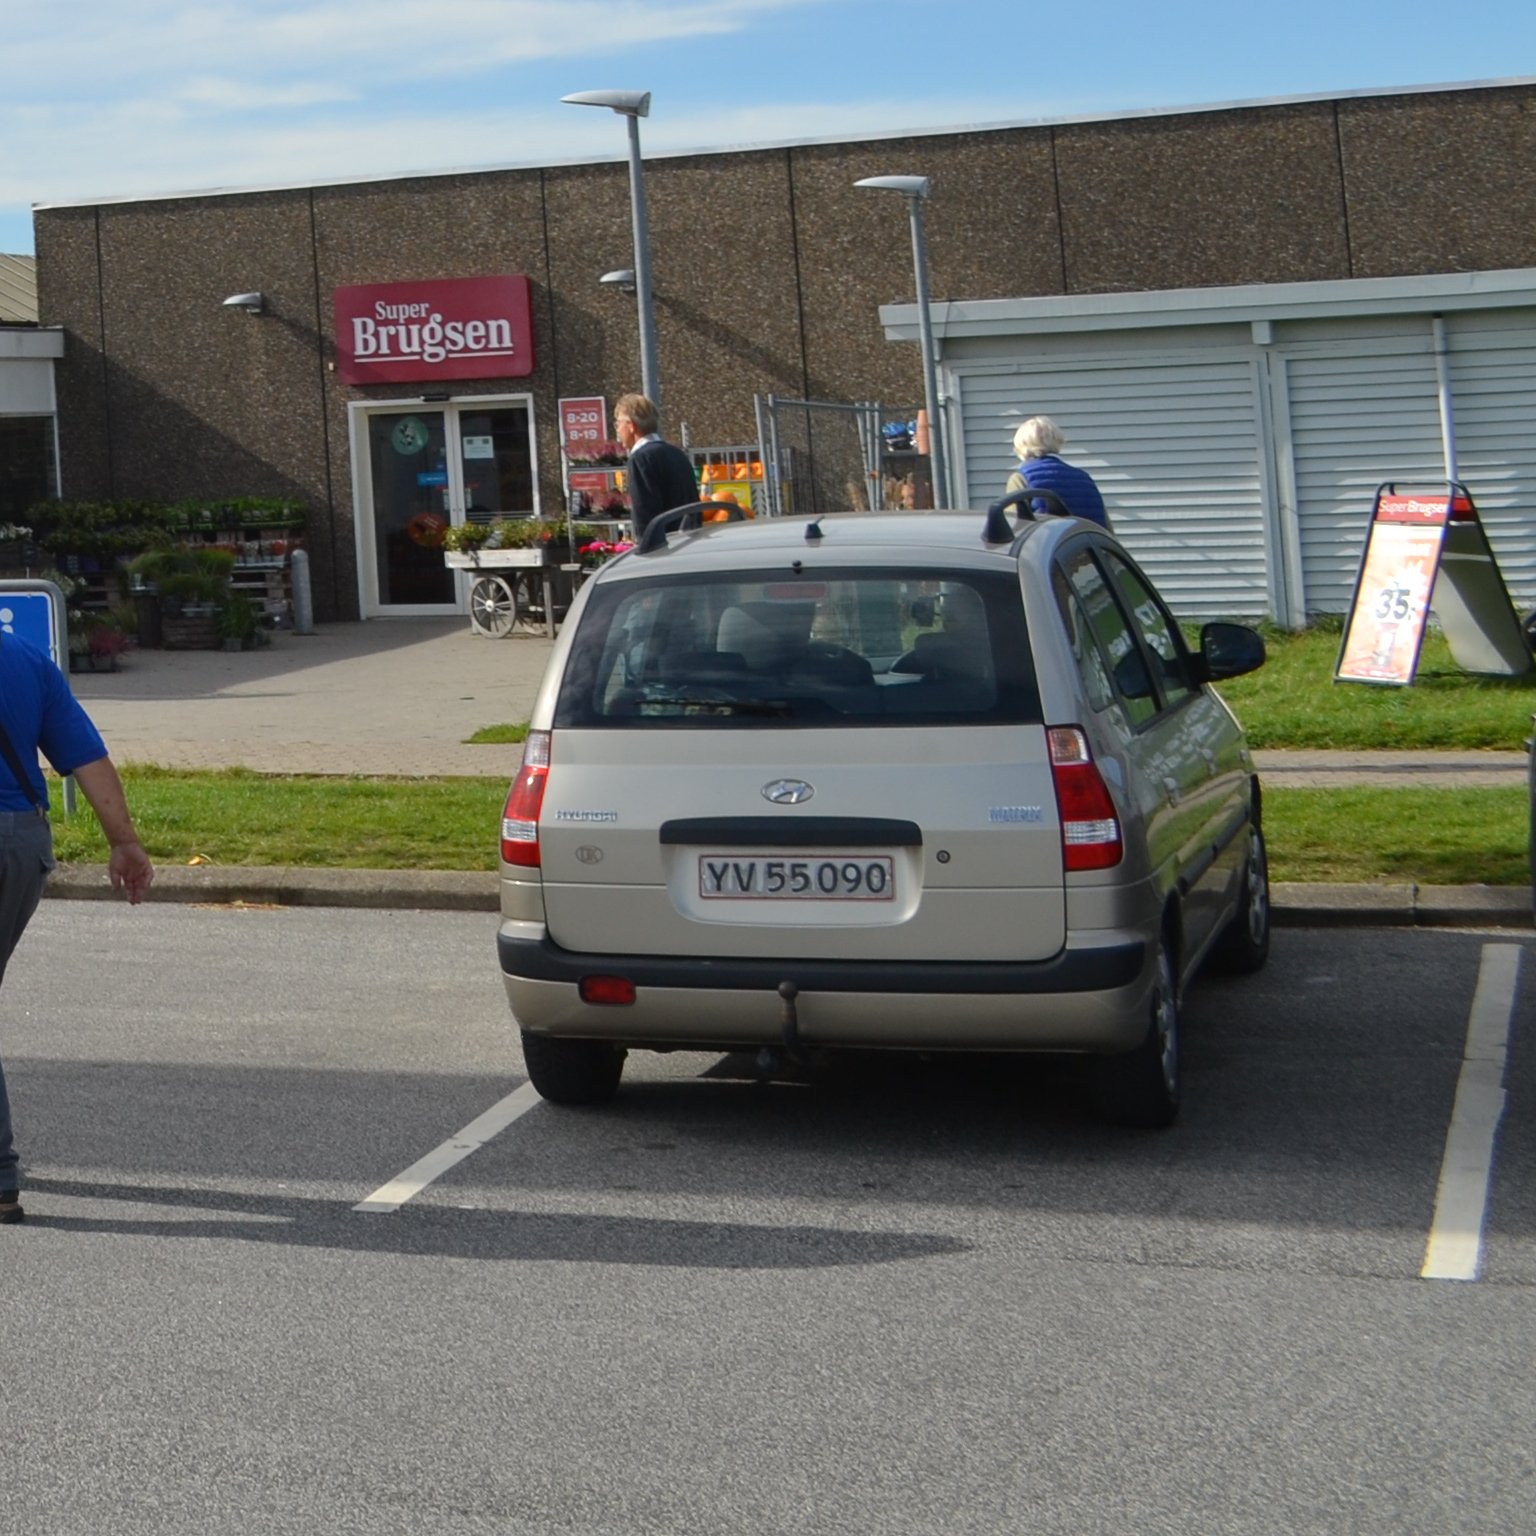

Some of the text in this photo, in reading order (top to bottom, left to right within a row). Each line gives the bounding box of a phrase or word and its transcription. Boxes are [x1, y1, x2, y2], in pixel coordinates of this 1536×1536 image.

[375, 300, 429, 324] Super
[352, 313, 514, 363] Brugsen
[554, 809, 618, 823] HYUNDAI
[707, 861, 755, 892] YV
